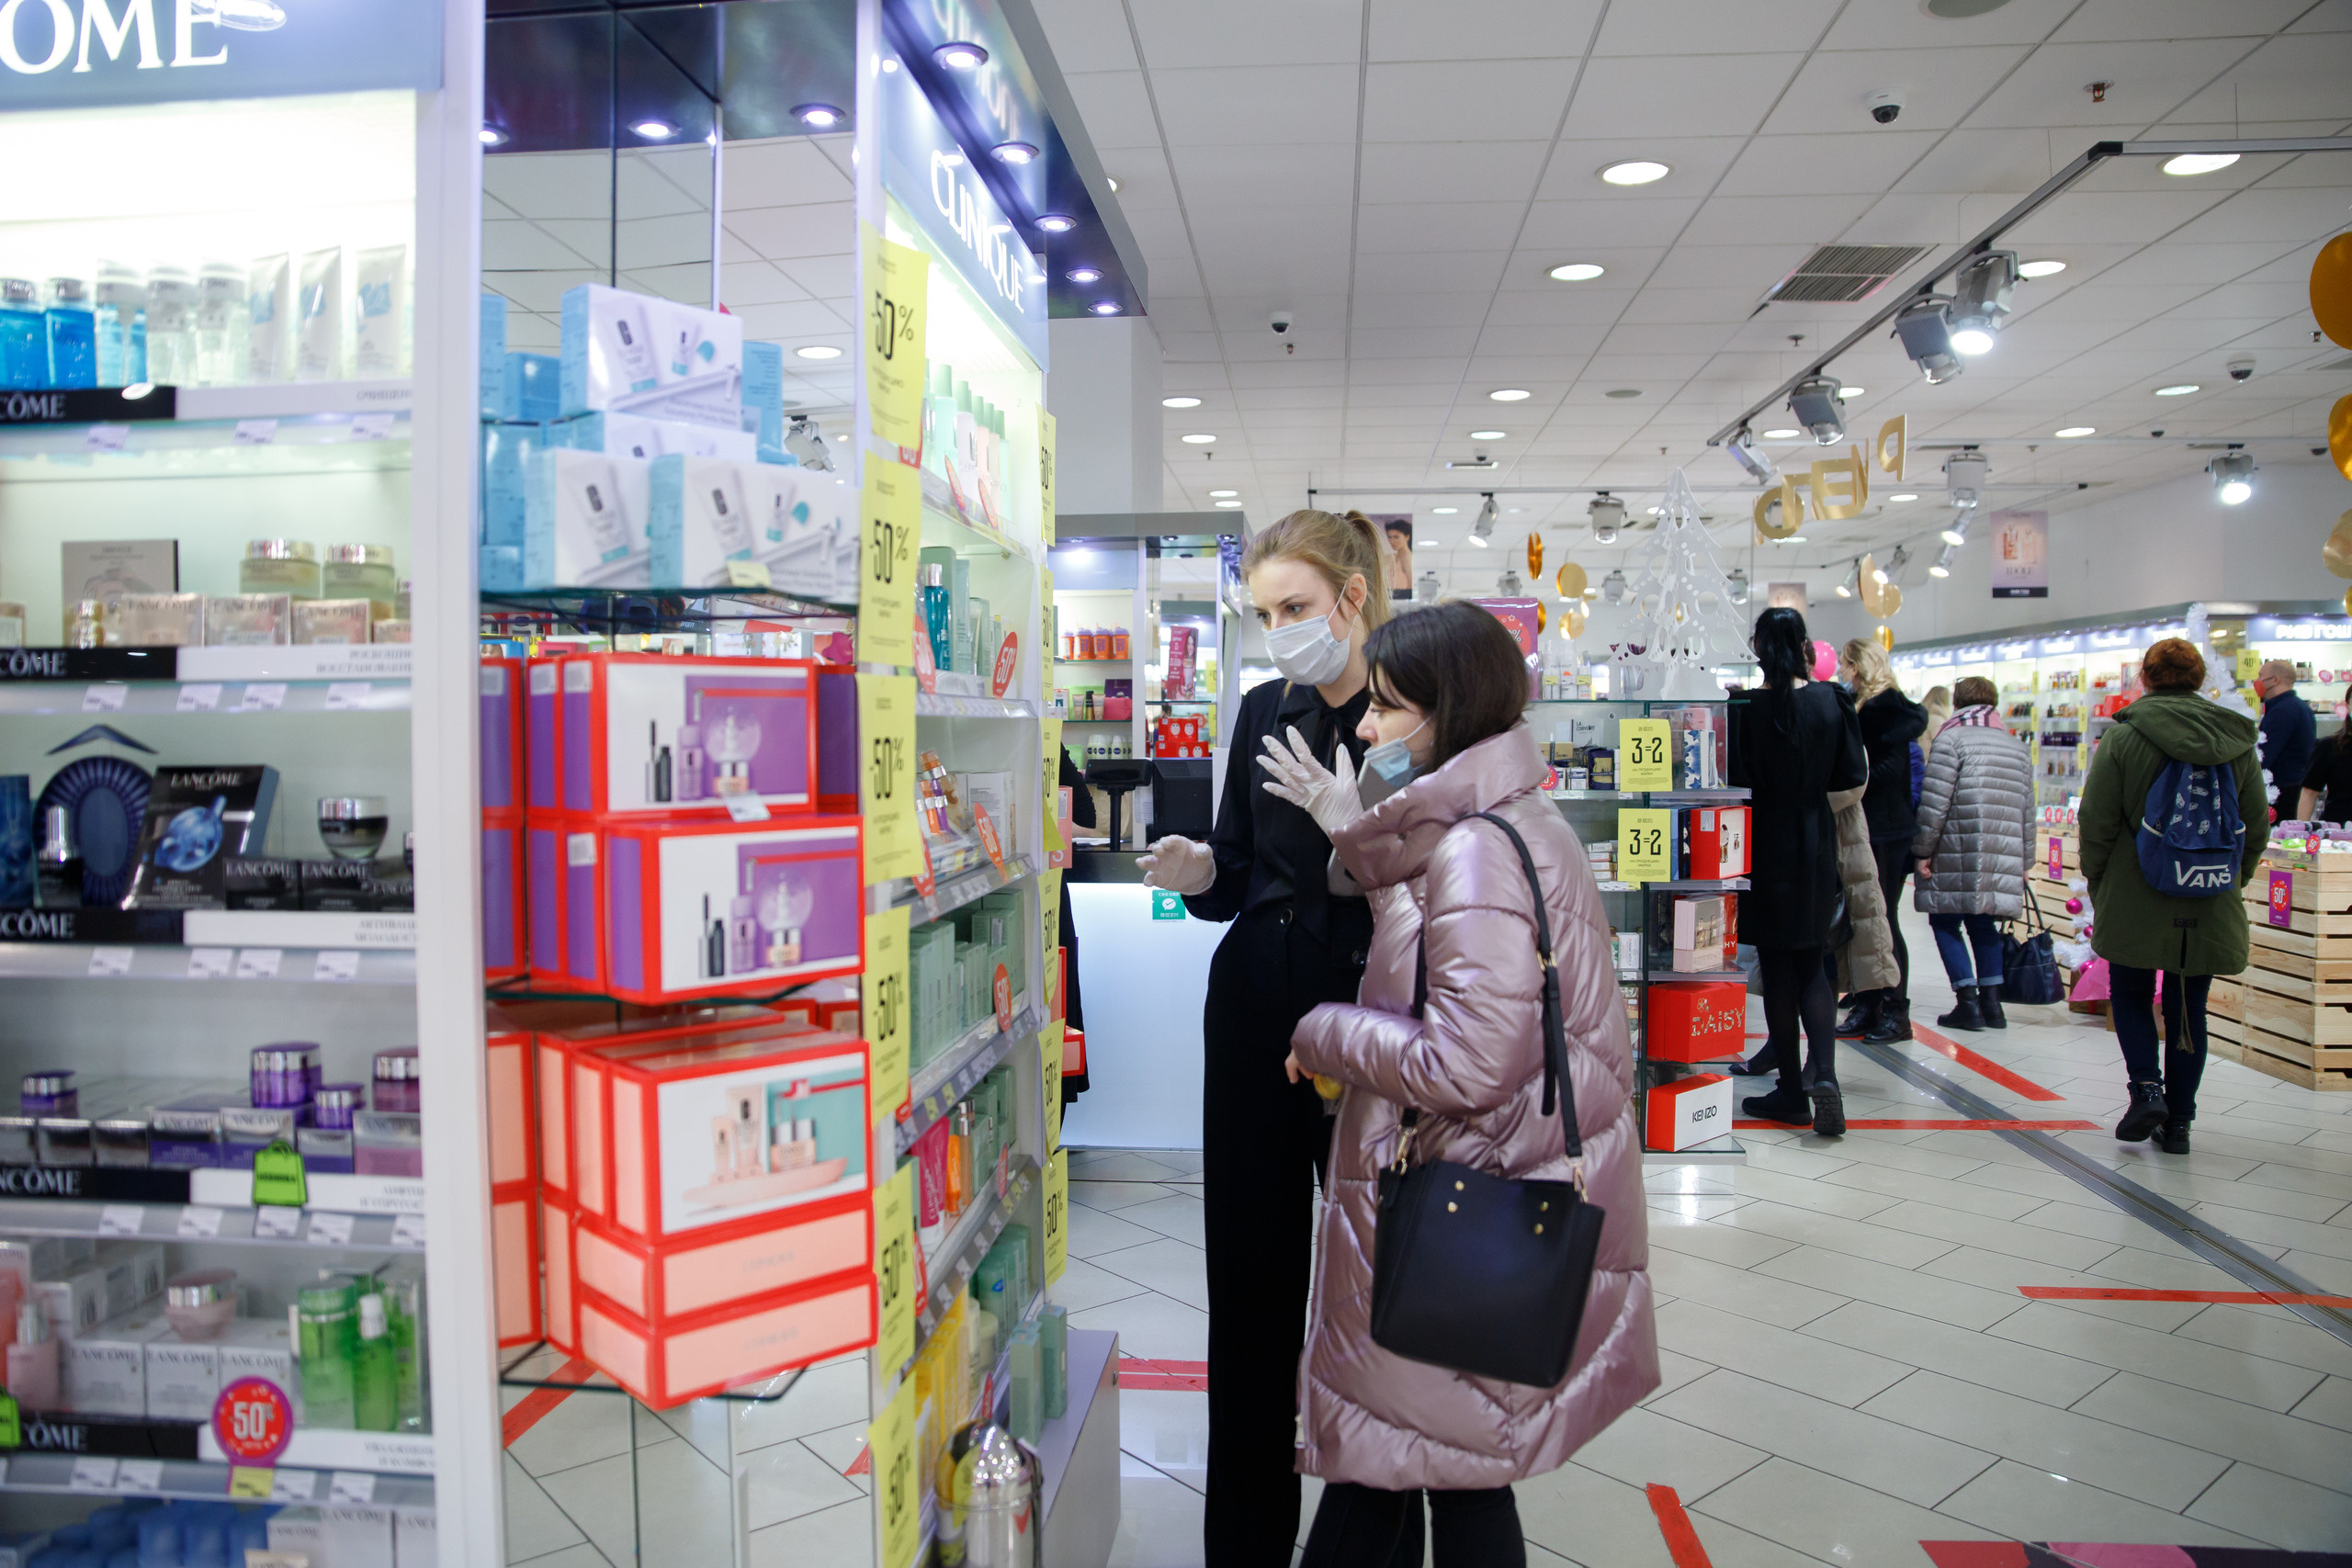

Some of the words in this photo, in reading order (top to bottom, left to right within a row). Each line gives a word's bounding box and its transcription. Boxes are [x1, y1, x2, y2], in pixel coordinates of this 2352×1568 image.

[931, 150, 1024, 314] CLINIQUE
[1631, 737, 1663, 764] 3=2
[1629, 829, 1661, 855] 3=2
[2174, 861, 2232, 887] VANS
[1690, 1006, 1746, 1037] DAISY
[1691, 1105, 1717, 1123] KENZO
